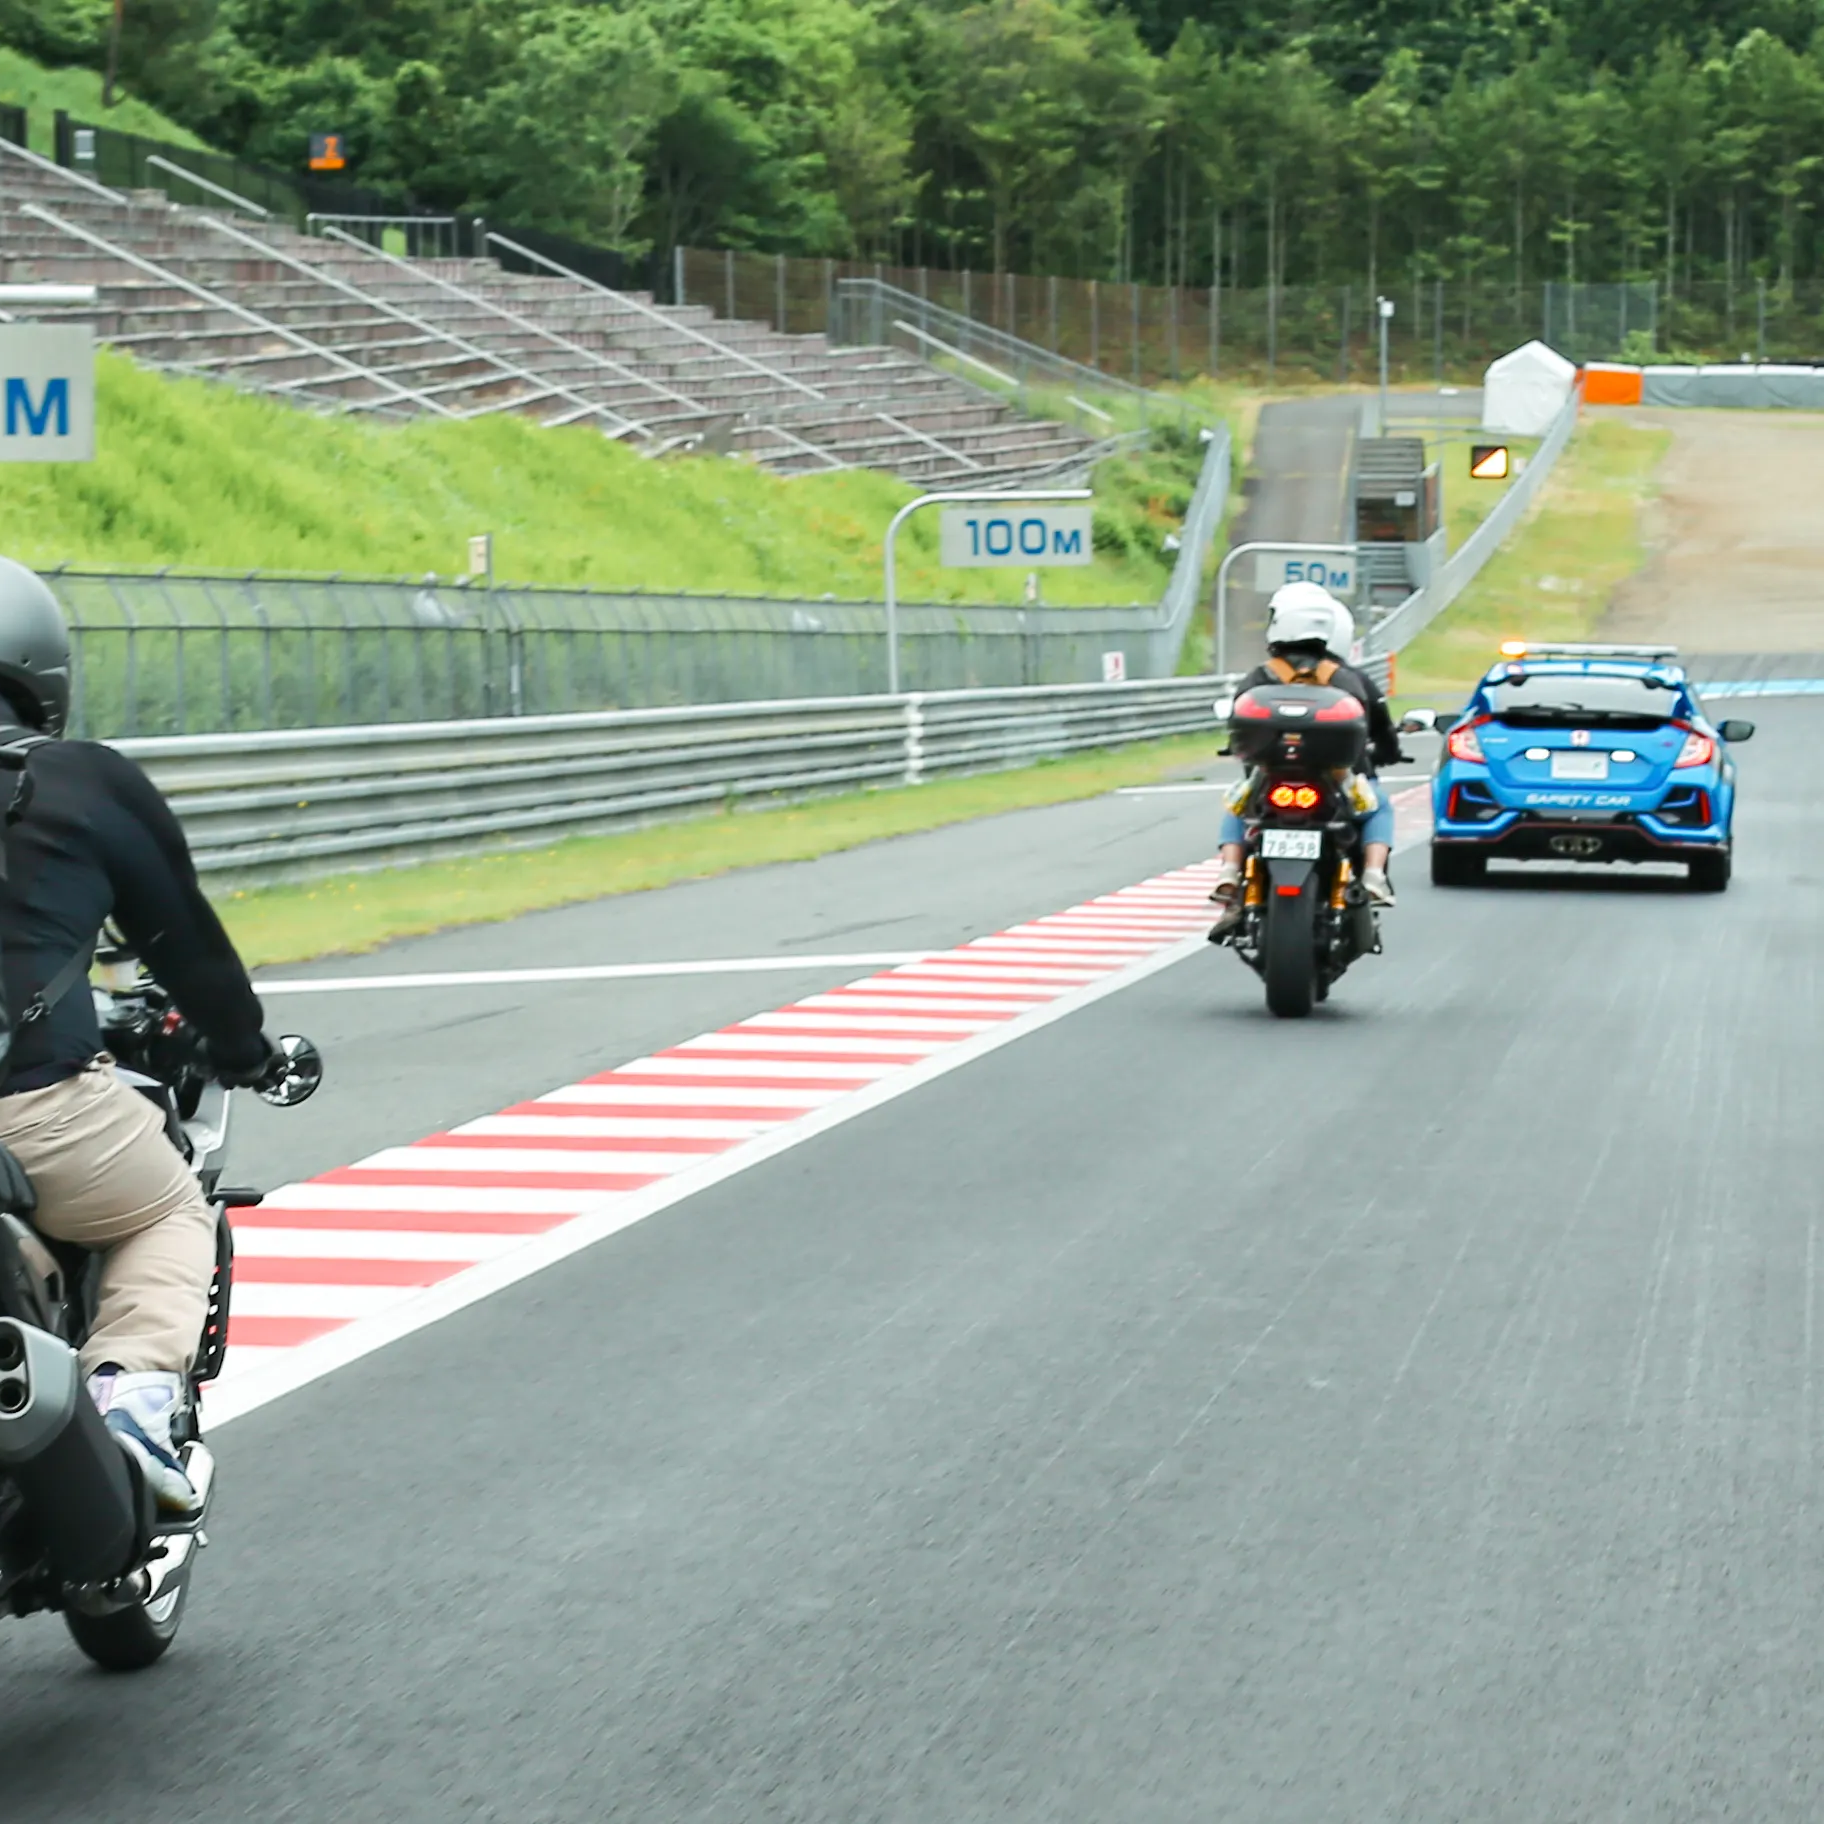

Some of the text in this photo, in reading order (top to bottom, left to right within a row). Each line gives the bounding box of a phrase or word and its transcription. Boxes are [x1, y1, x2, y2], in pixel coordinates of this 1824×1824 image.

[965, 517, 1082, 557] 100M
[1284, 561, 1349, 588] 50M
[1524, 793, 1632, 808] SAFETY CAR
